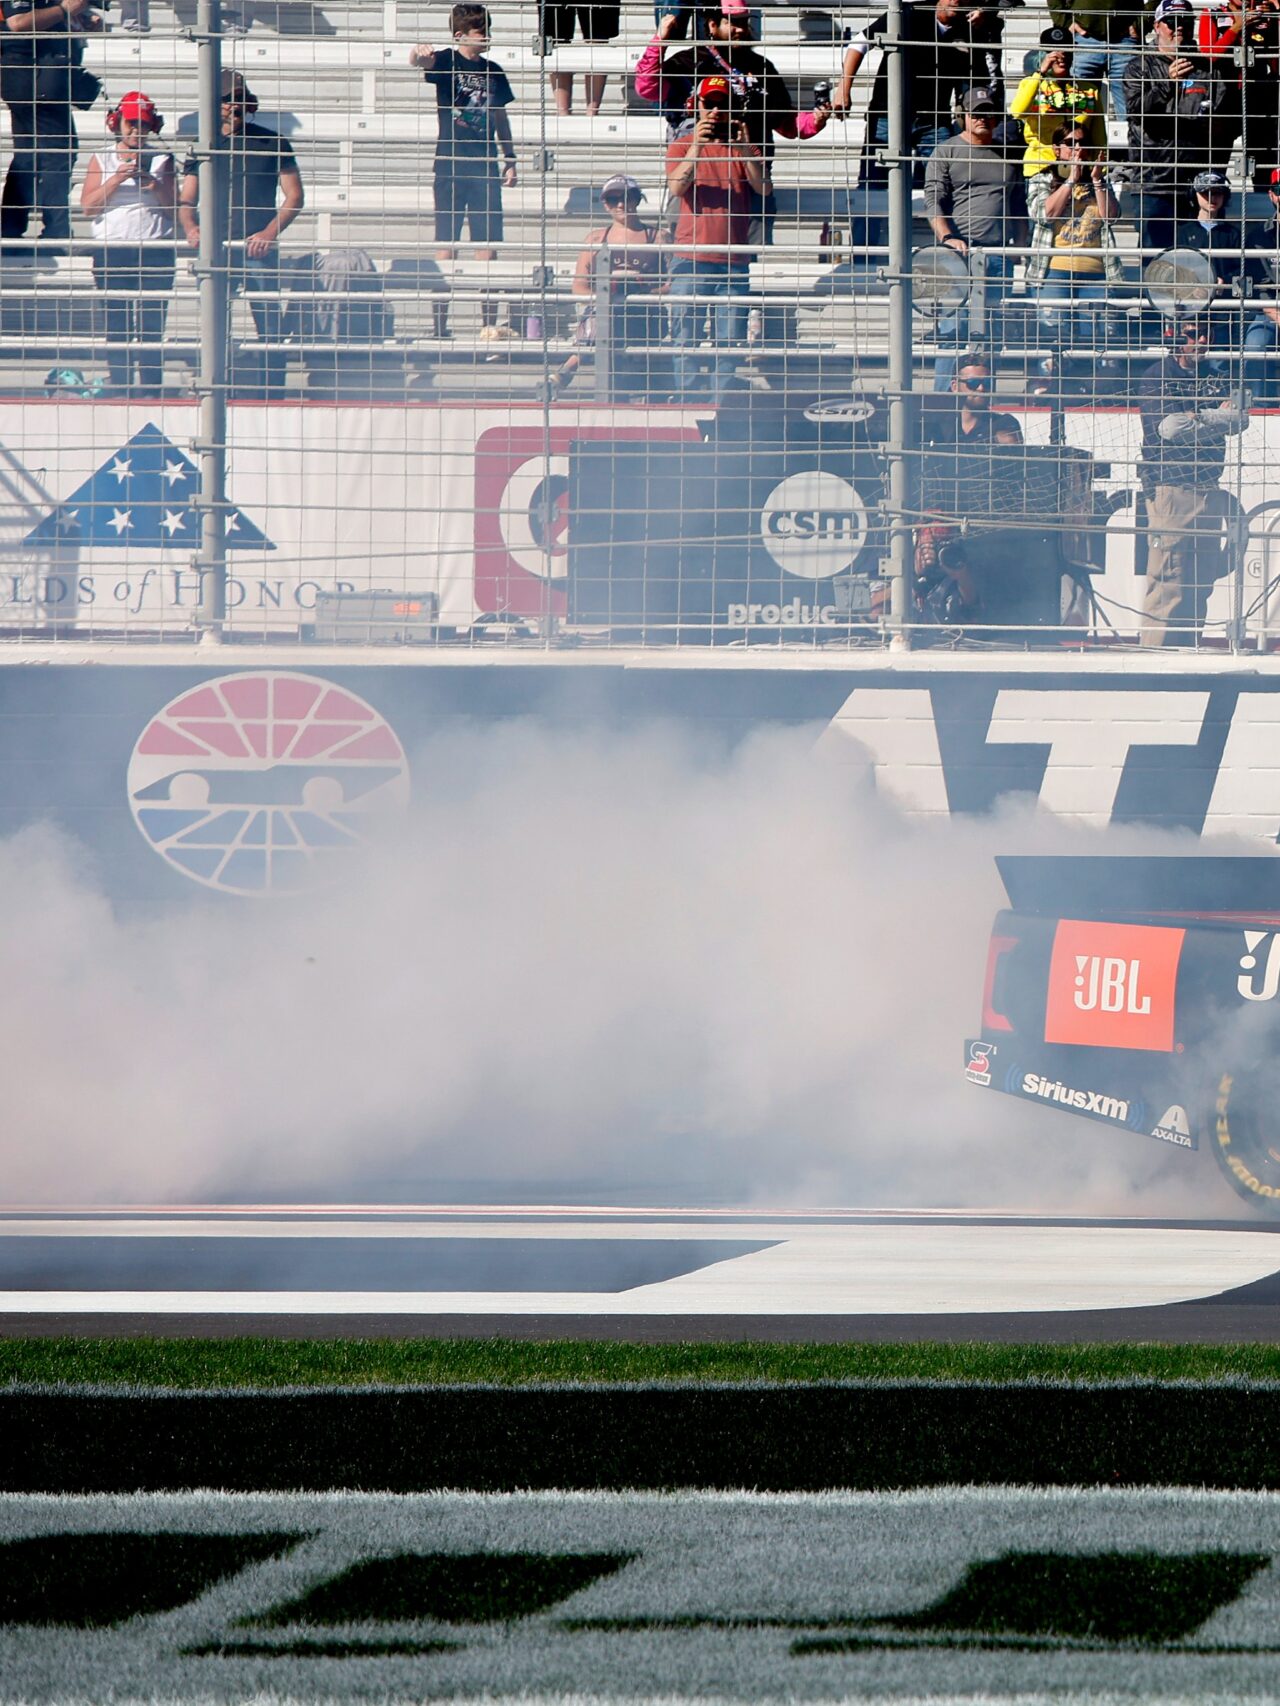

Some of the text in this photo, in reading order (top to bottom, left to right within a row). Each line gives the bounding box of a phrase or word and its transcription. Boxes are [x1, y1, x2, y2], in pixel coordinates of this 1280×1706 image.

[767, 510, 860, 541] csm
[113, 569, 157, 614] of
[1074, 955, 1152, 1015] JBL
[1151, 1127, 1193, 1148] AXALTA
